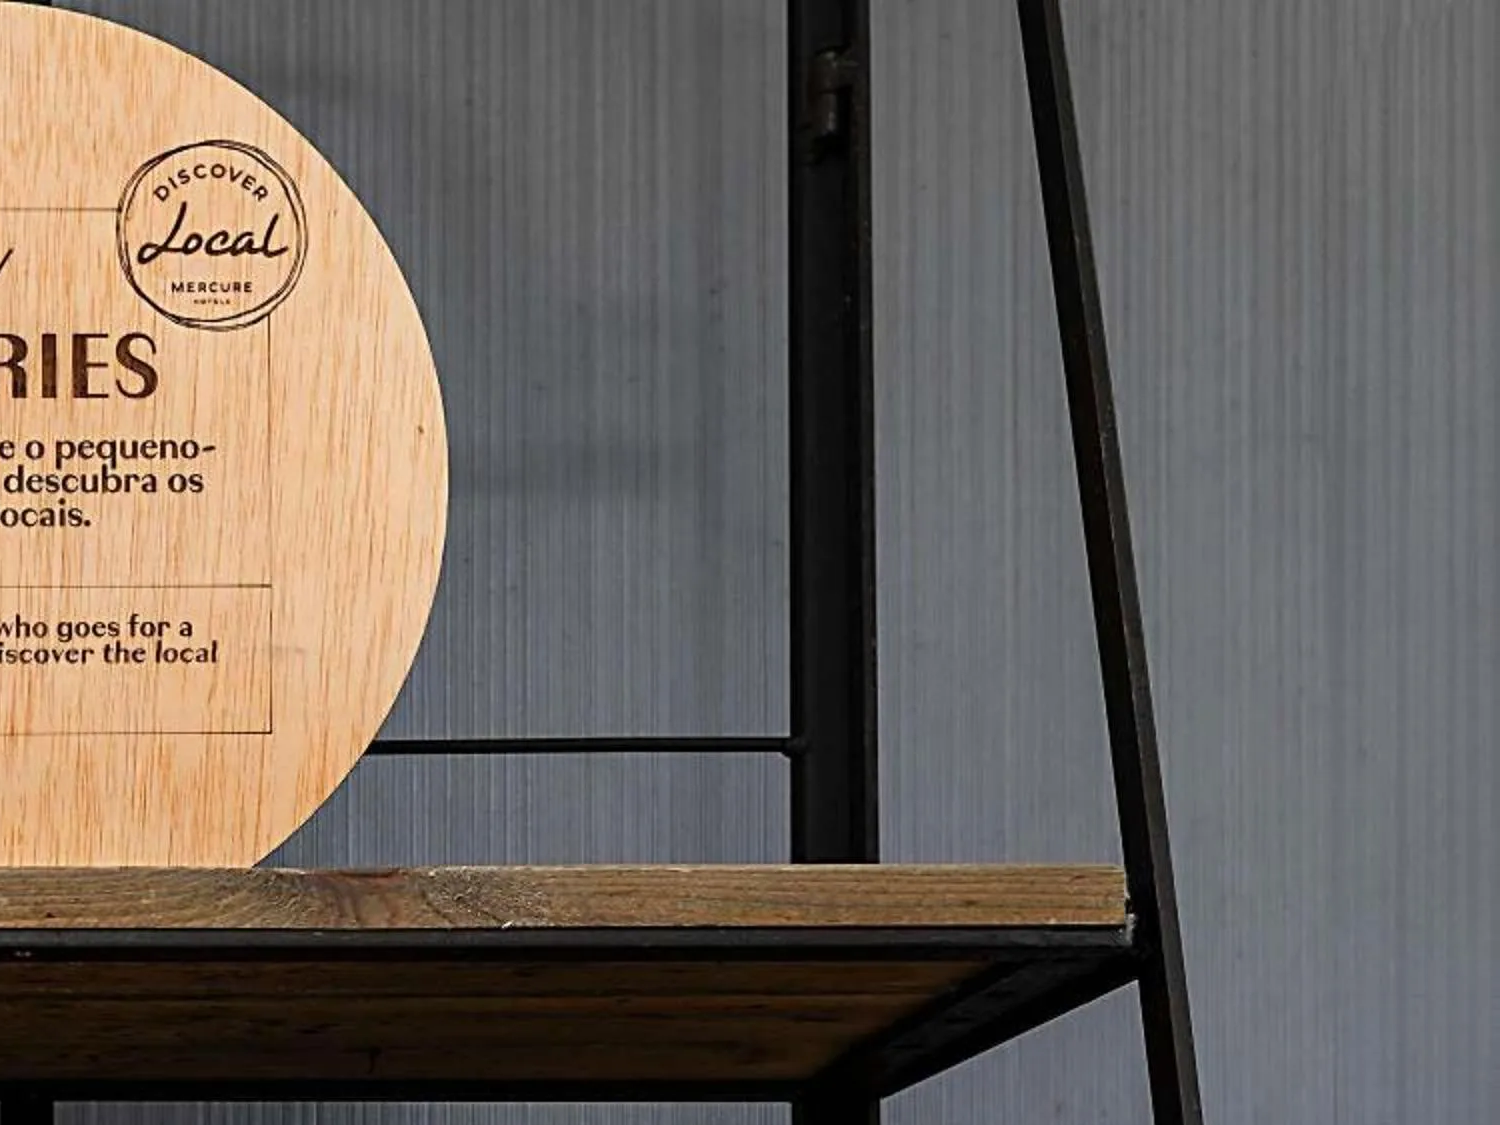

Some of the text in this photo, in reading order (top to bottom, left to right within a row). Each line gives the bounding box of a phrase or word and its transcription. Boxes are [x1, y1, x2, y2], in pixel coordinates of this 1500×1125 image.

[153, 163, 269, 202] DISCOVER
[137, 201, 289, 265] Local
[171, 281, 253, 293] MERCURE
[25, 439, 45, 461] o
[55, 439, 216, 471] pequeno-
[3, 463, 157, 494] descubra
[167, 473, 204, 494] os
[56, 621, 120, 643] goes
[128, 613, 171, 638] for
[179, 621, 193, 638] a
[103, 639, 146, 664] the
[155, 639, 218, 664] local
